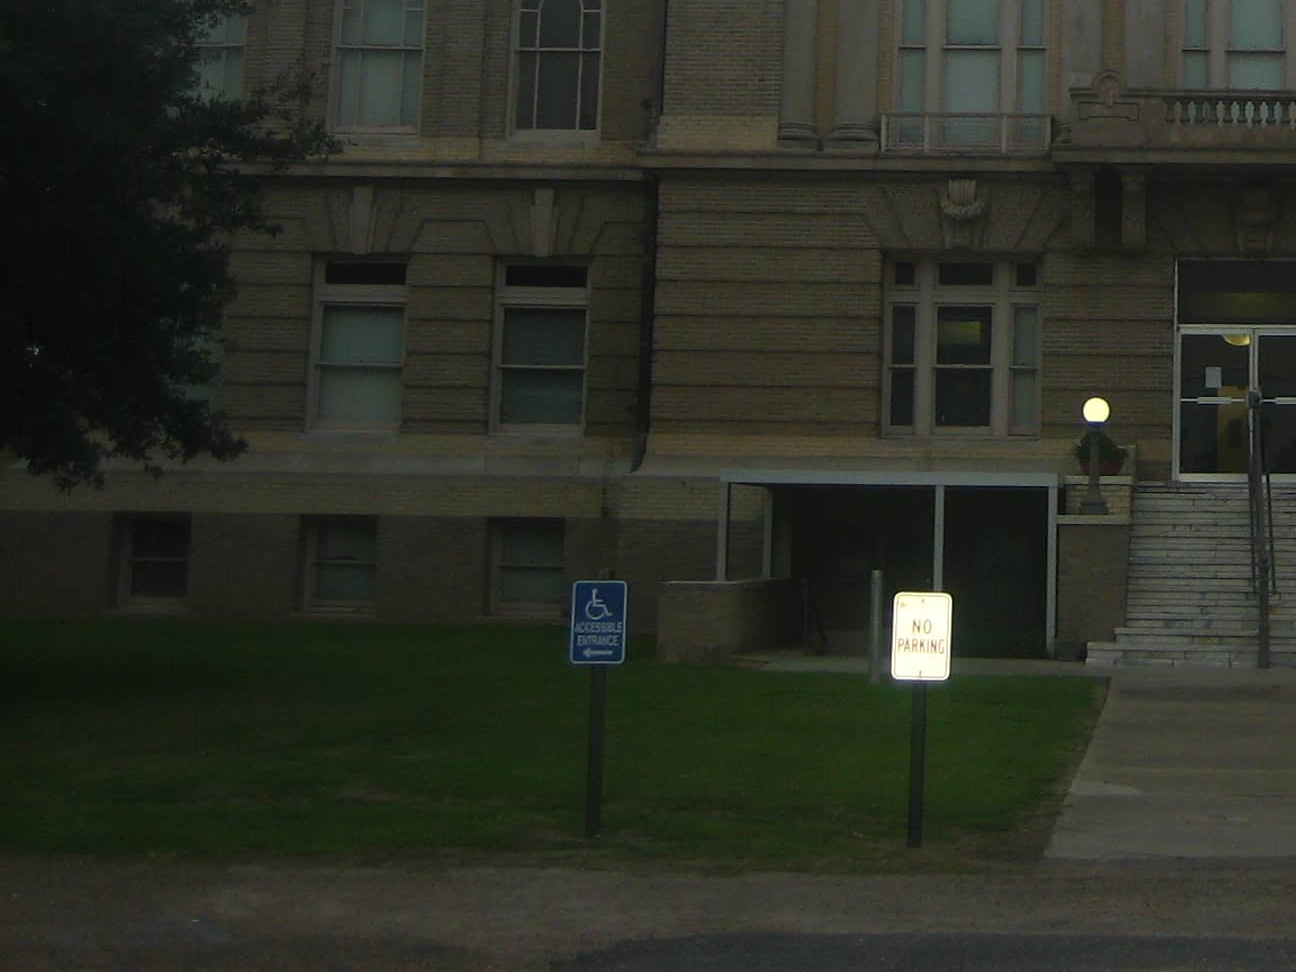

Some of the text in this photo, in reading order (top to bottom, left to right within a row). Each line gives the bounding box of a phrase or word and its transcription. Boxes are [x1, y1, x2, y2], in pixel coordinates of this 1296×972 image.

[574, 621, 624, 633] ACCESSIBLE
[912, 619, 932, 634] NO
[576, 635, 620, 646] ENTRANCE
[897, 637, 945, 654] PARKING
